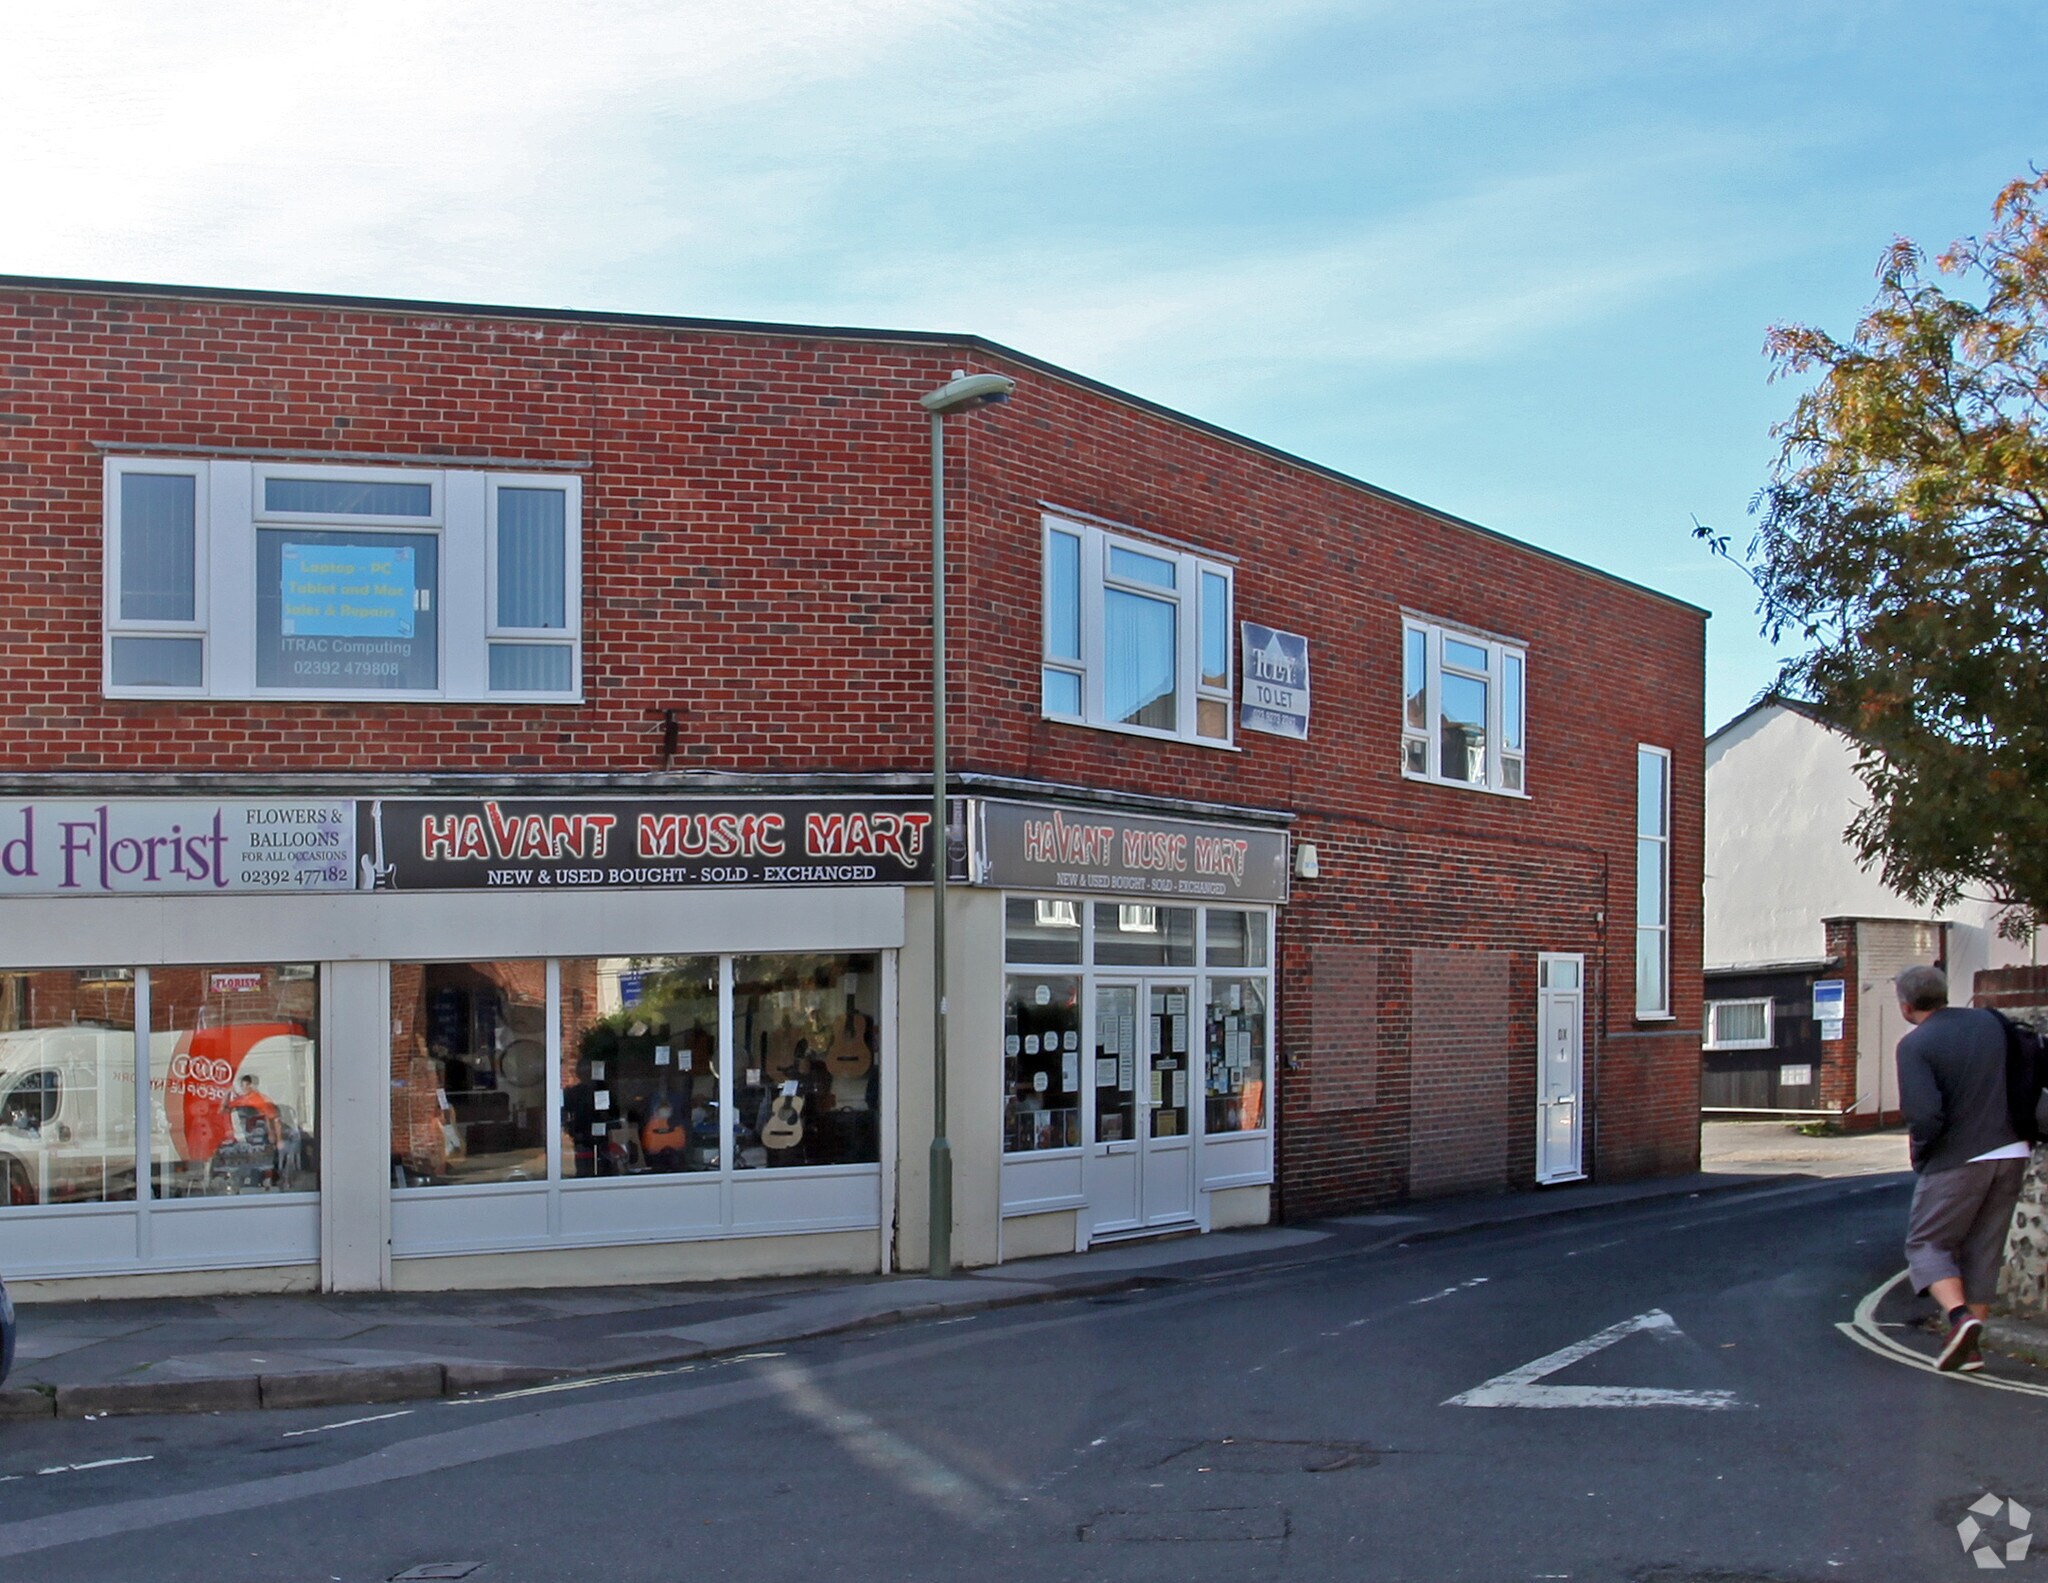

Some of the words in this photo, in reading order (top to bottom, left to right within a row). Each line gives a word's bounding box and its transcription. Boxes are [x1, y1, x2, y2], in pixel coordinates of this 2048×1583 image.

[300, 560, 355, 576] Laptop
[369, 561, 392, 576] PC
[288, 580, 336, 595] Tablet
[341, 584, 370, 596] and
[374, 584, 404, 597] Mac
[324, 603, 336, 616] &
[340, 603, 396, 619] Repairs
[281, 638, 328, 653] ITRAC
[331, 640, 412, 657] Computing
[294, 660, 341, 675] 02392
[344, 660, 399, 676] 479808
[1257, 686, 1271, 704] TO
[1274, 690, 1293, 709] LET
[246, 808, 327, 824] FLOWERS
[331, 808, 343, 824] &
[250, 831, 339, 847] BALLOONS
[422, 800, 616, 860] HAVANT
[638, 814, 786, 858] MUSIC
[806, 813, 932, 868] MART
[0, 804, 39, 876] d
[58, 805, 230, 891] Florist
[241, 852, 263, 862] FOR
[265, 851, 286, 862] ALL
[287, 850, 348, 861] OCCASIONS
[1024, 811, 1115, 867] HAVANT
[1122, 829, 1188, 871] MUSIC
[1195, 836, 1249, 887] MART
[241, 869, 290, 886] 02392
[294, 865, 348, 885] 477182
[487, 869, 534, 885] NEW
[537, 869, 551, 884] &
[554, 869, 604, 885] USED
[608, 867, 686, 884] BOUGHT
[701, 867, 748, 883] SOLD
[763, 865, 876, 882] EXCHANGED
[1056, 872, 1079, 886] NEW
[1079, 874, 1087, 886] &
[1087, 874, 1111, 888] USED
[1111, 875, 1146, 890] BOUGHT
[1151, 878, 1173, 892] SOLD
[1178, 880, 1227, 895] EXCHANGED
[216, 978, 256, 989] FLORIST
